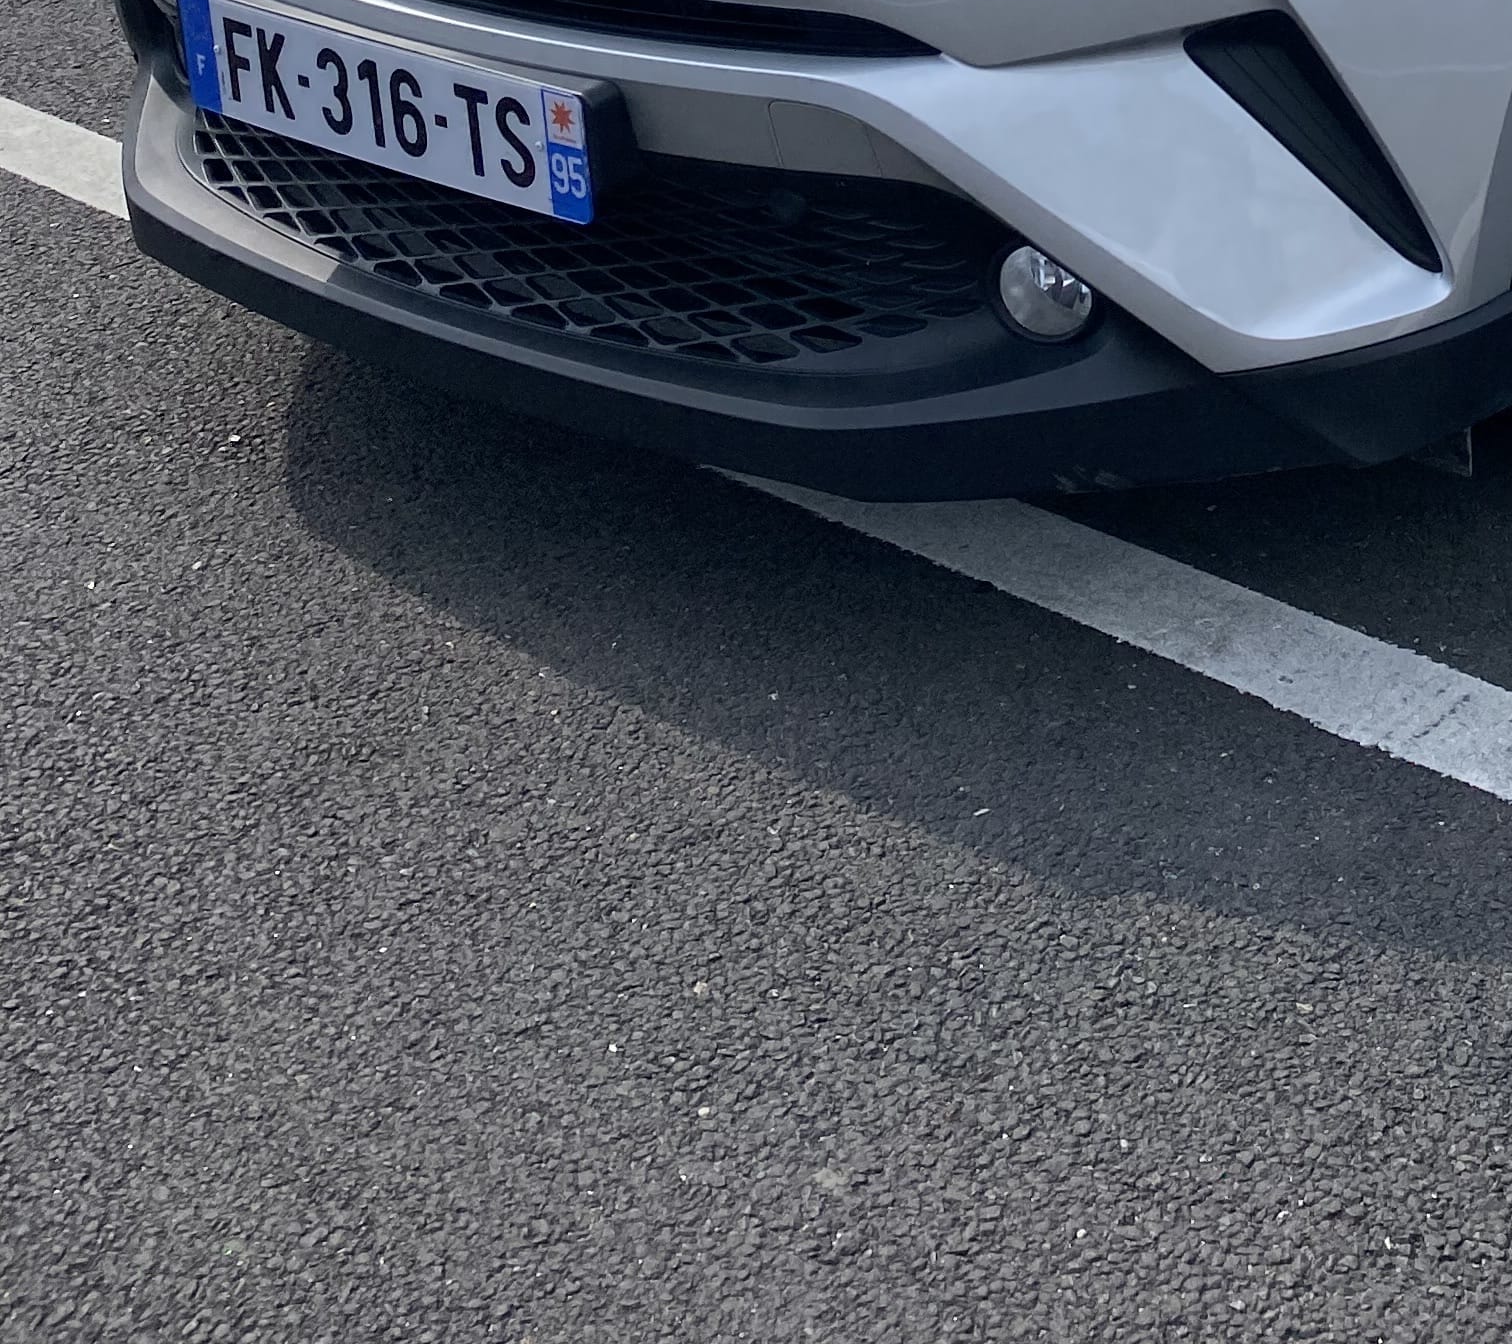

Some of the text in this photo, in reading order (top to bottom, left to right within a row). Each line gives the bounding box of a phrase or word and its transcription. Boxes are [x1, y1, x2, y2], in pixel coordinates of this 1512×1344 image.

[196, 53, 206, 76] F
[222, 16, 536, 188] FK-316-TS
[551, 152, 588, 200] 95
